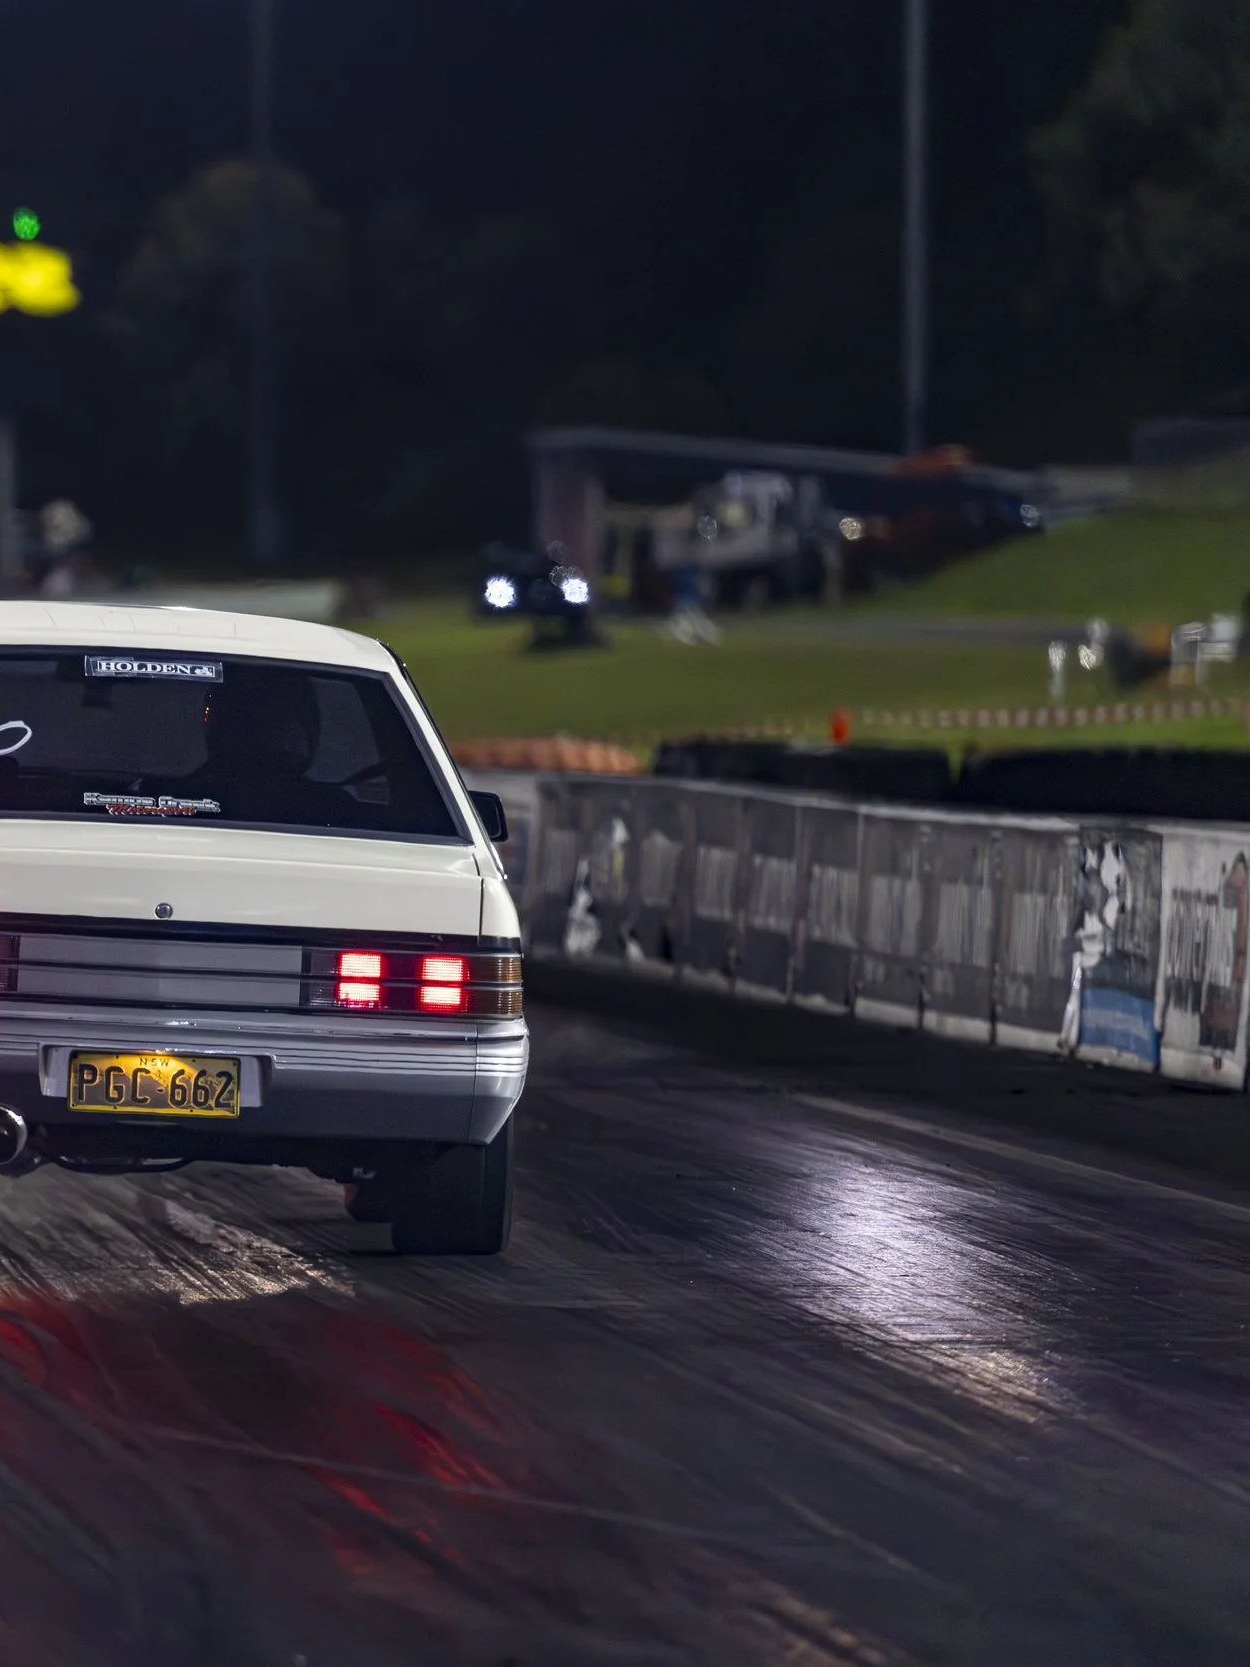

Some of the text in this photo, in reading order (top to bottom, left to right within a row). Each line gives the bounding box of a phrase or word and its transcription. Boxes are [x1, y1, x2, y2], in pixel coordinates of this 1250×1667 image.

[100, 660, 191, 675] HOLDEN
[139, 1057, 170, 1067] NSW
[77, 1063, 236, 1109] PGC 662
